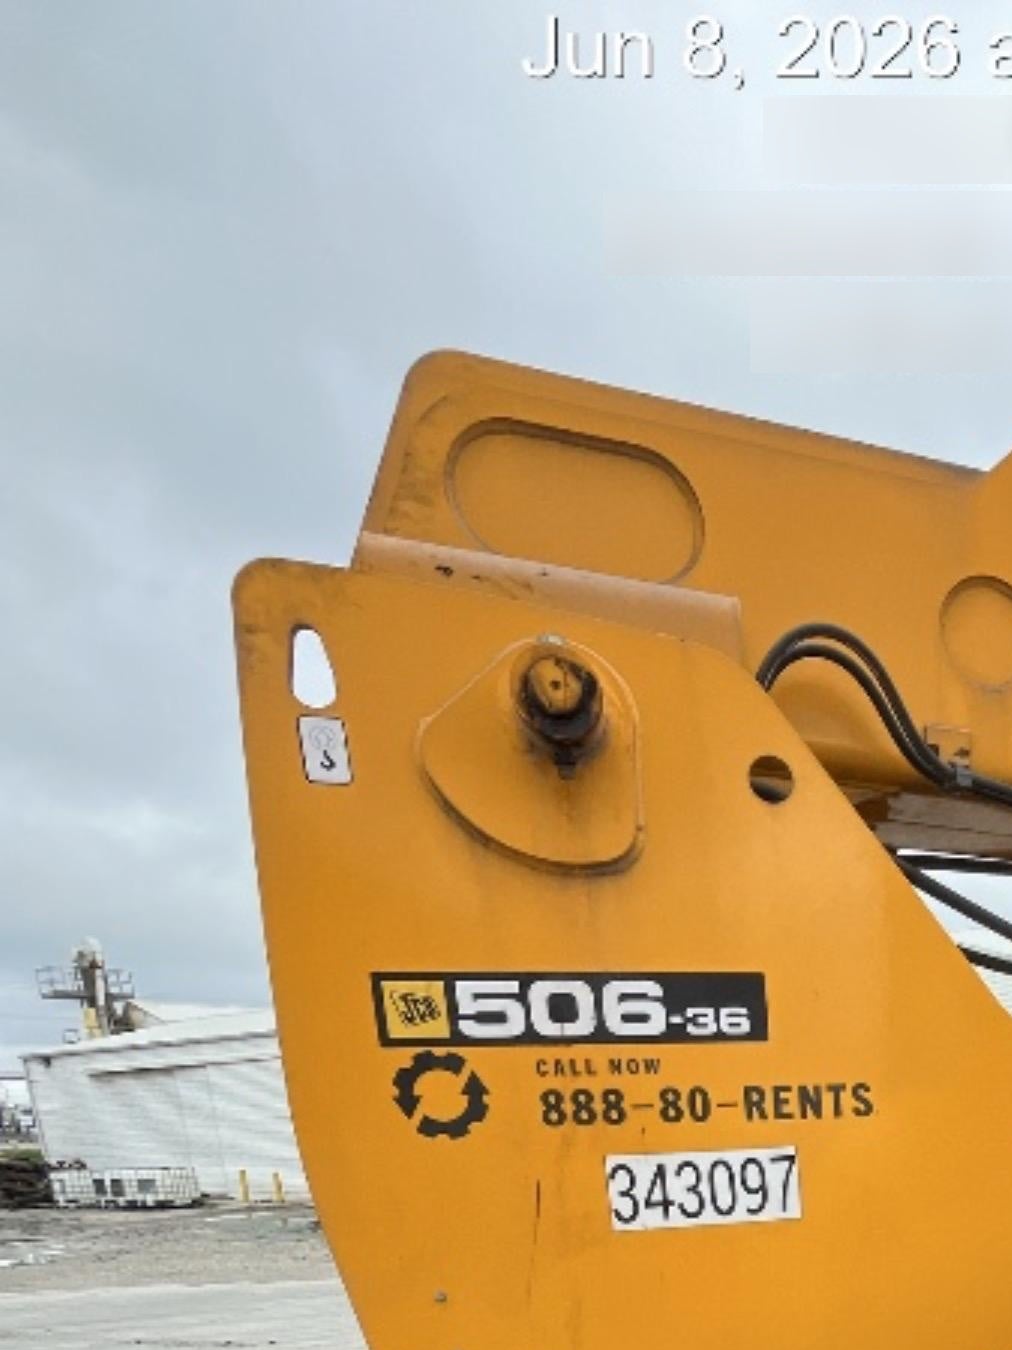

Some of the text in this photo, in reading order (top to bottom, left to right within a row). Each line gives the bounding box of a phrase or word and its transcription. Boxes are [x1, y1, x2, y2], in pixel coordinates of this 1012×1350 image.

[454, 979, 752, 1039] 506-36
[535, 1057, 662, 1078] CALL NOW
[539, 1082, 875, 1127] 888-80-RENTS
[608, 1154, 797, 1225] 343097
